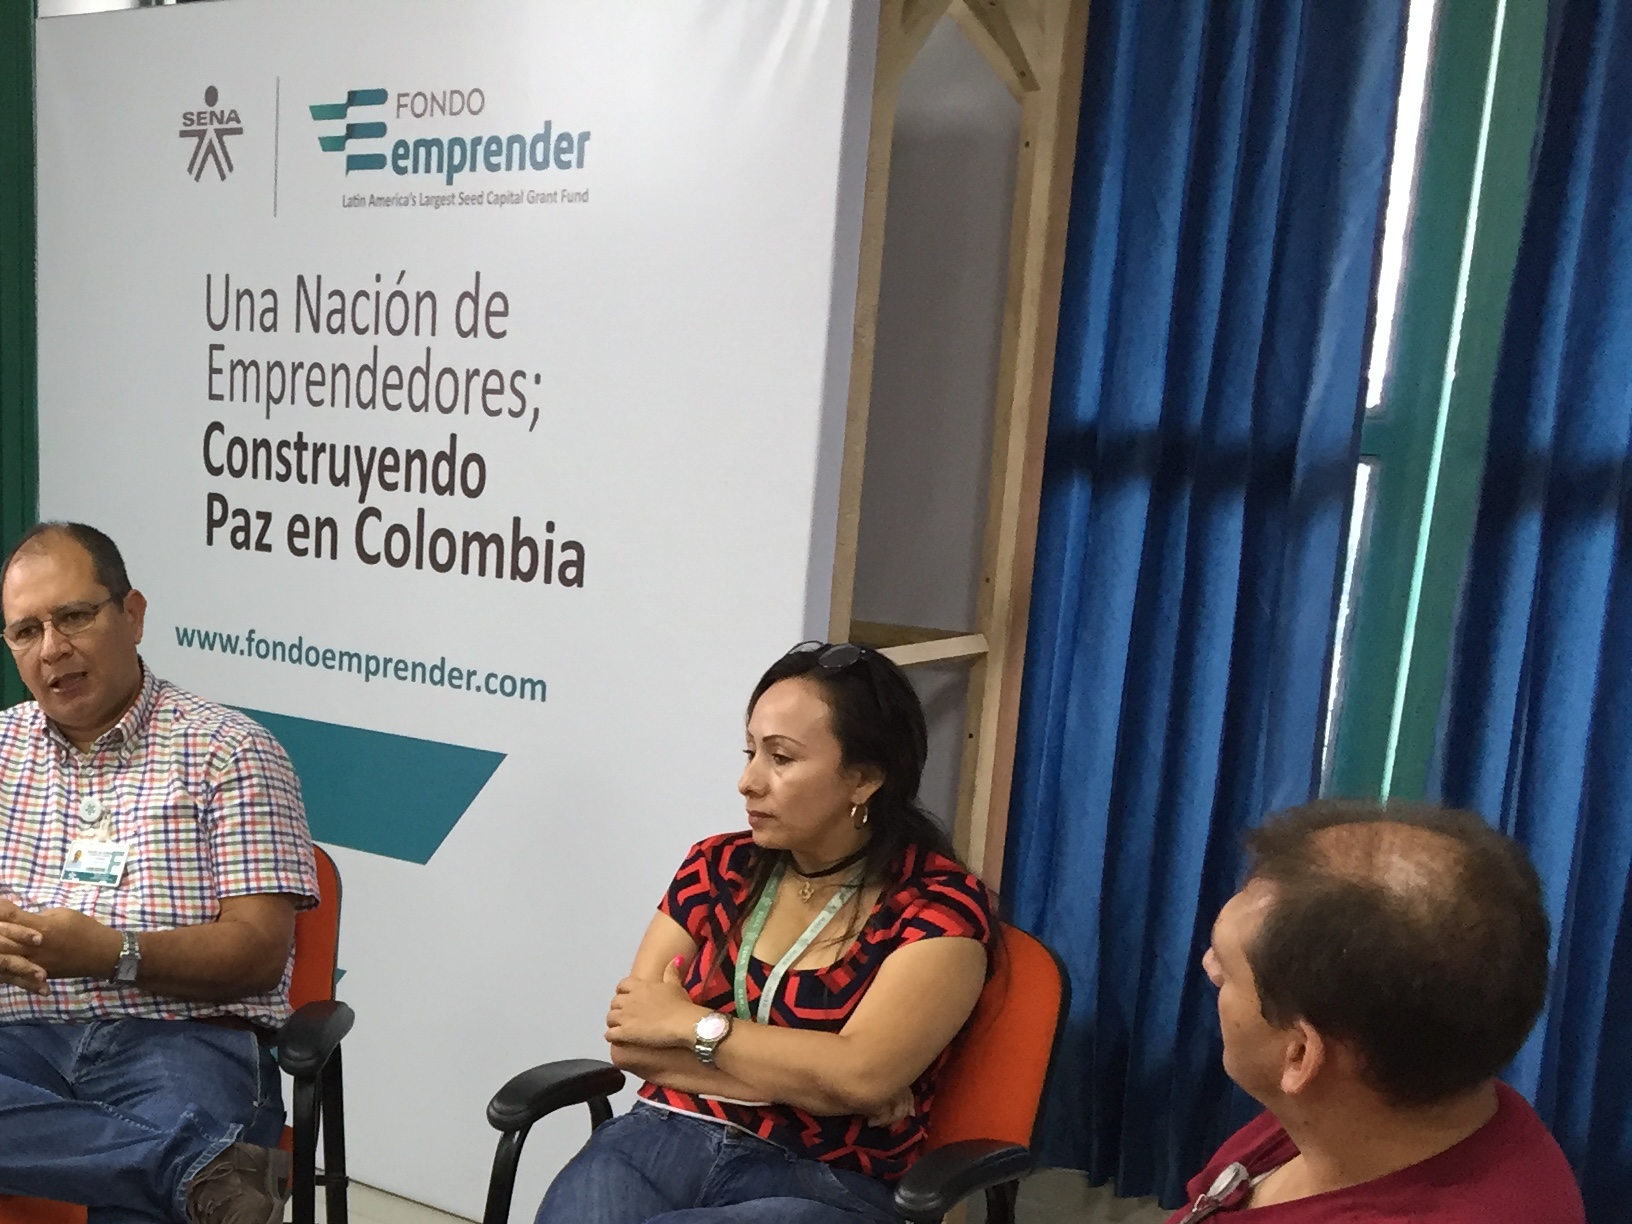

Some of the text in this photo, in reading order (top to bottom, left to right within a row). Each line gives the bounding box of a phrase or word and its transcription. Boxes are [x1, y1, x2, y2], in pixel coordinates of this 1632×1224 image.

[182, 109, 241, 127] SENA
[396, 87, 486, 119] FONDO
[391, 120, 591, 186] emprender
[342, 188, 589, 210] Latin America's Largest Seed Capital Grant Fund
[205, 269, 510, 339] Una Nación de
[207, 343, 543, 432] Emprendedores;
[202, 421, 487, 503] Construyendo
[206, 492, 586, 588] Paz en Colombia
[174, 624, 548, 703] www.fondoemprender.com
